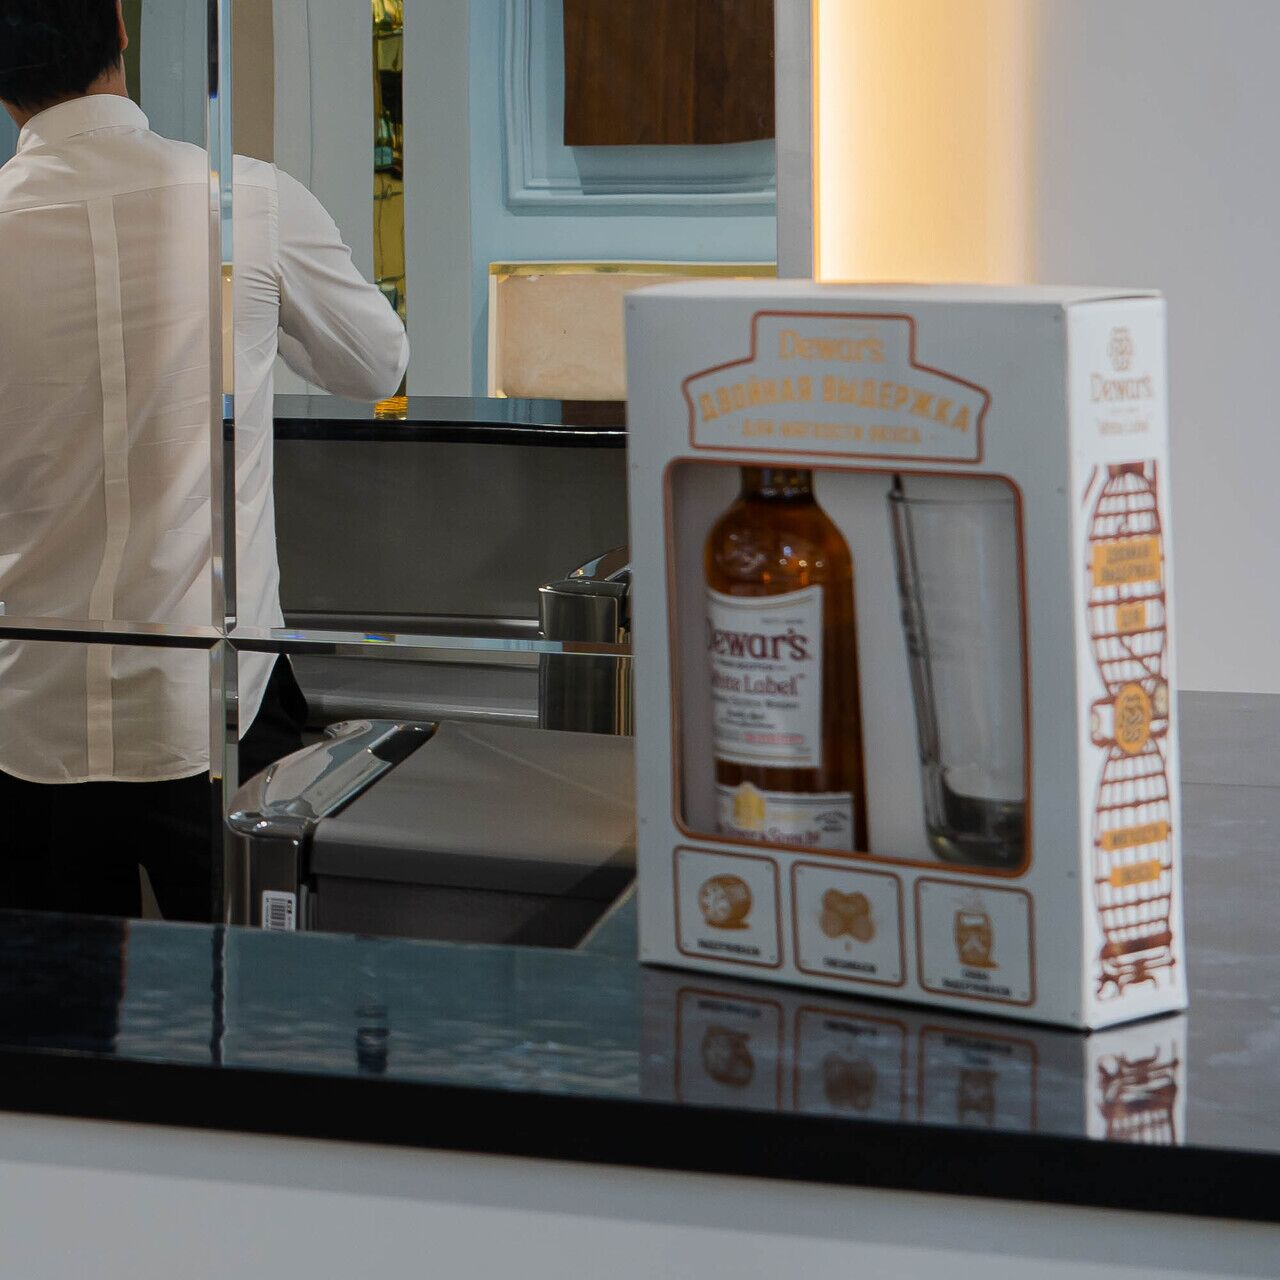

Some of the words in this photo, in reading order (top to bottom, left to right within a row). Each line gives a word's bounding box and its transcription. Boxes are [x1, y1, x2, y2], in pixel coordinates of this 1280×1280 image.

[778, 328, 885, 364] Dewar's
[699, 375, 813, 423] ДВОЙНАЯ
[822, 374, 971, 433] ВЫДЕРЖКА
[1090, 372, 1153, 403] Dewar's
[706, 618, 811, 661] ewar's
[743, 671, 798, 697] Label
